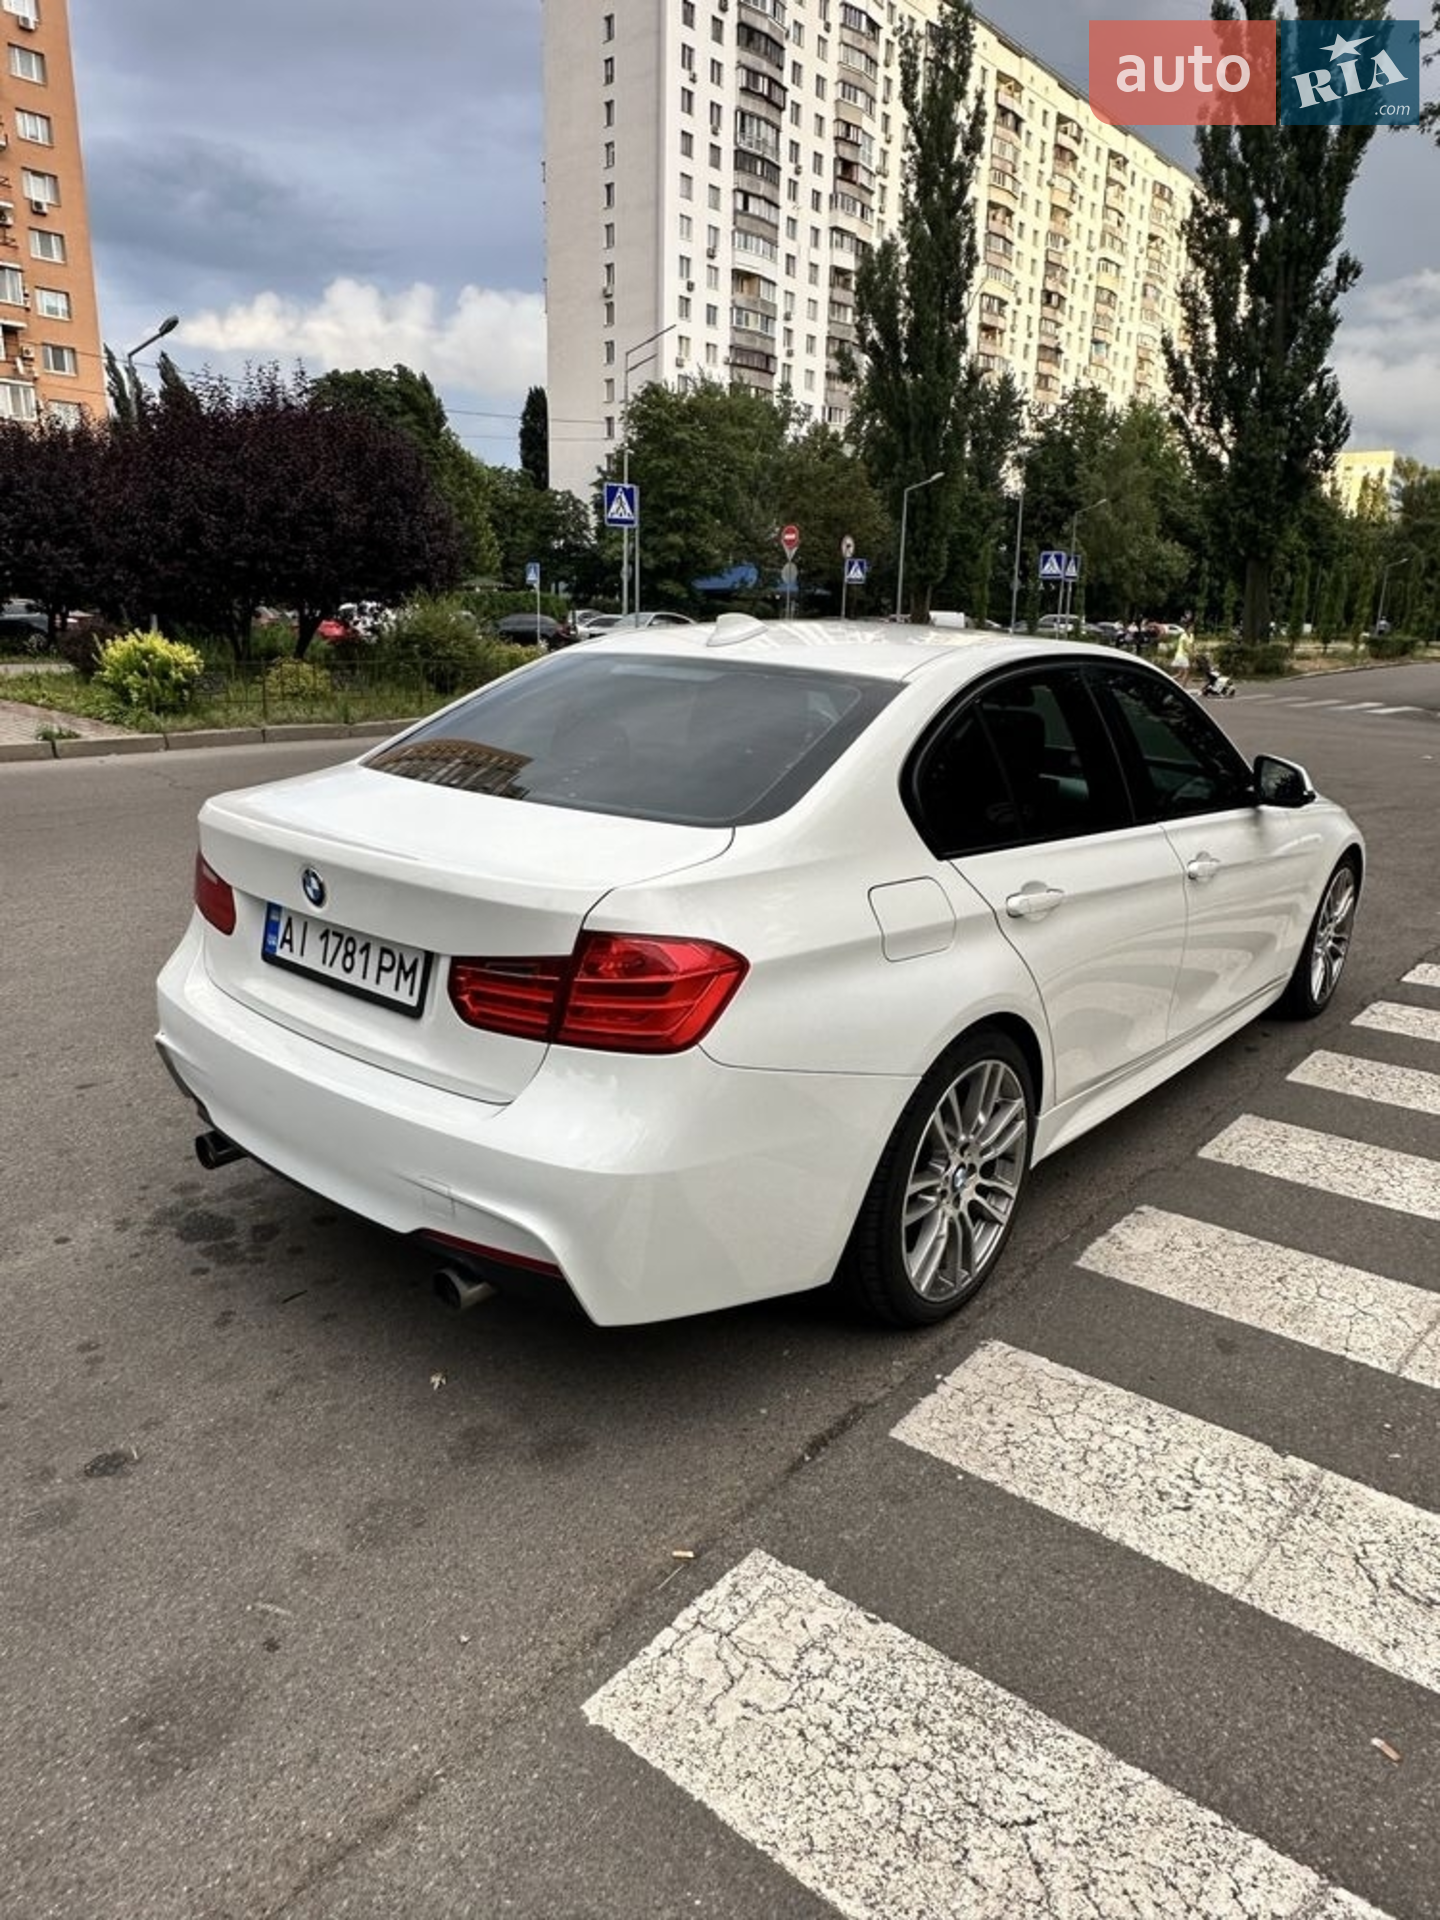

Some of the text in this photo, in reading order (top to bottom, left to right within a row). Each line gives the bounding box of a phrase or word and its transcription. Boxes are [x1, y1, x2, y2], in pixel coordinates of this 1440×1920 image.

[279, 916, 419, 997] AI 1781 PM
